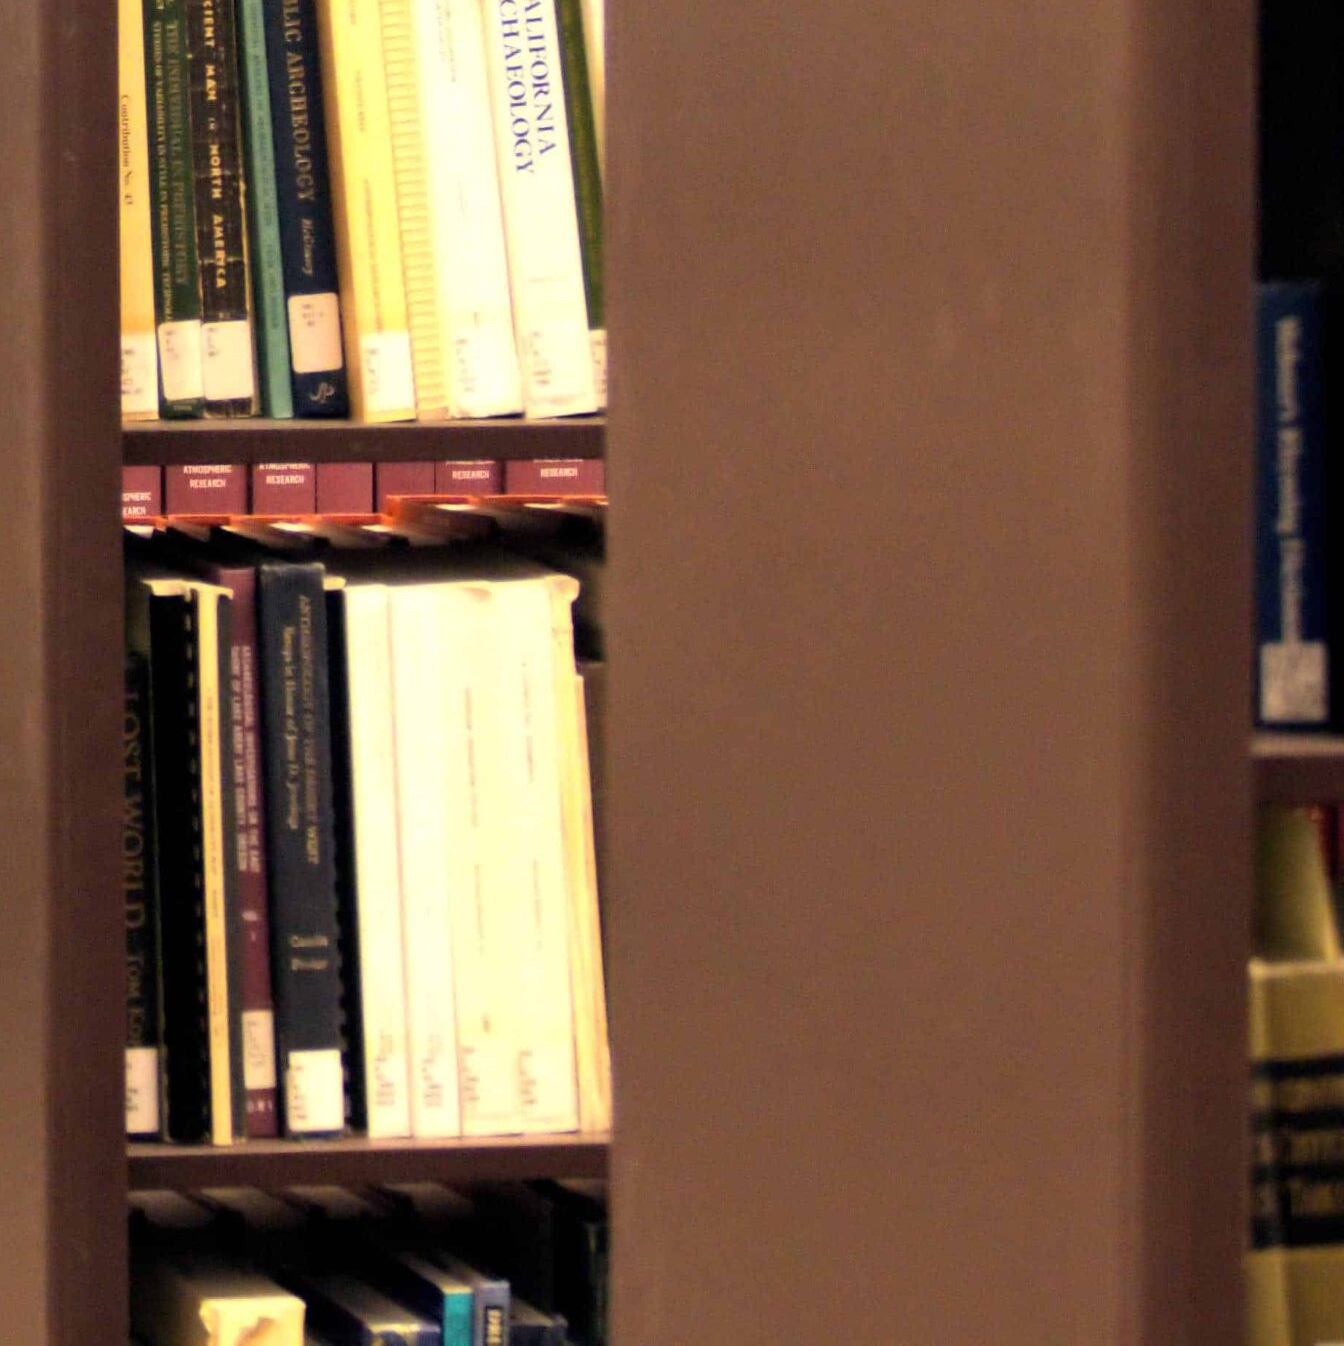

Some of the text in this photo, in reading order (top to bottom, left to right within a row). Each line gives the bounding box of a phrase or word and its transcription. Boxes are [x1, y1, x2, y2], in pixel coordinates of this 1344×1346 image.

[206, 65, 217, 100] MAN
[120, 95, 130, 167] Contribution
[286, 52, 314, 201] ARCHEOLOGY
[209, 144, 222, 199] NORTH
[212, 214, 227, 289] AMERICA
[183, 465, 232, 474] ATMOSPHERIC
[266, 475, 305, 485] RESEARCH
[452, 470, 489, 479] RESEARCH
[541, 468, 578, 477] RESEARCH
[189, 479, 226, 489] RESEARCH
